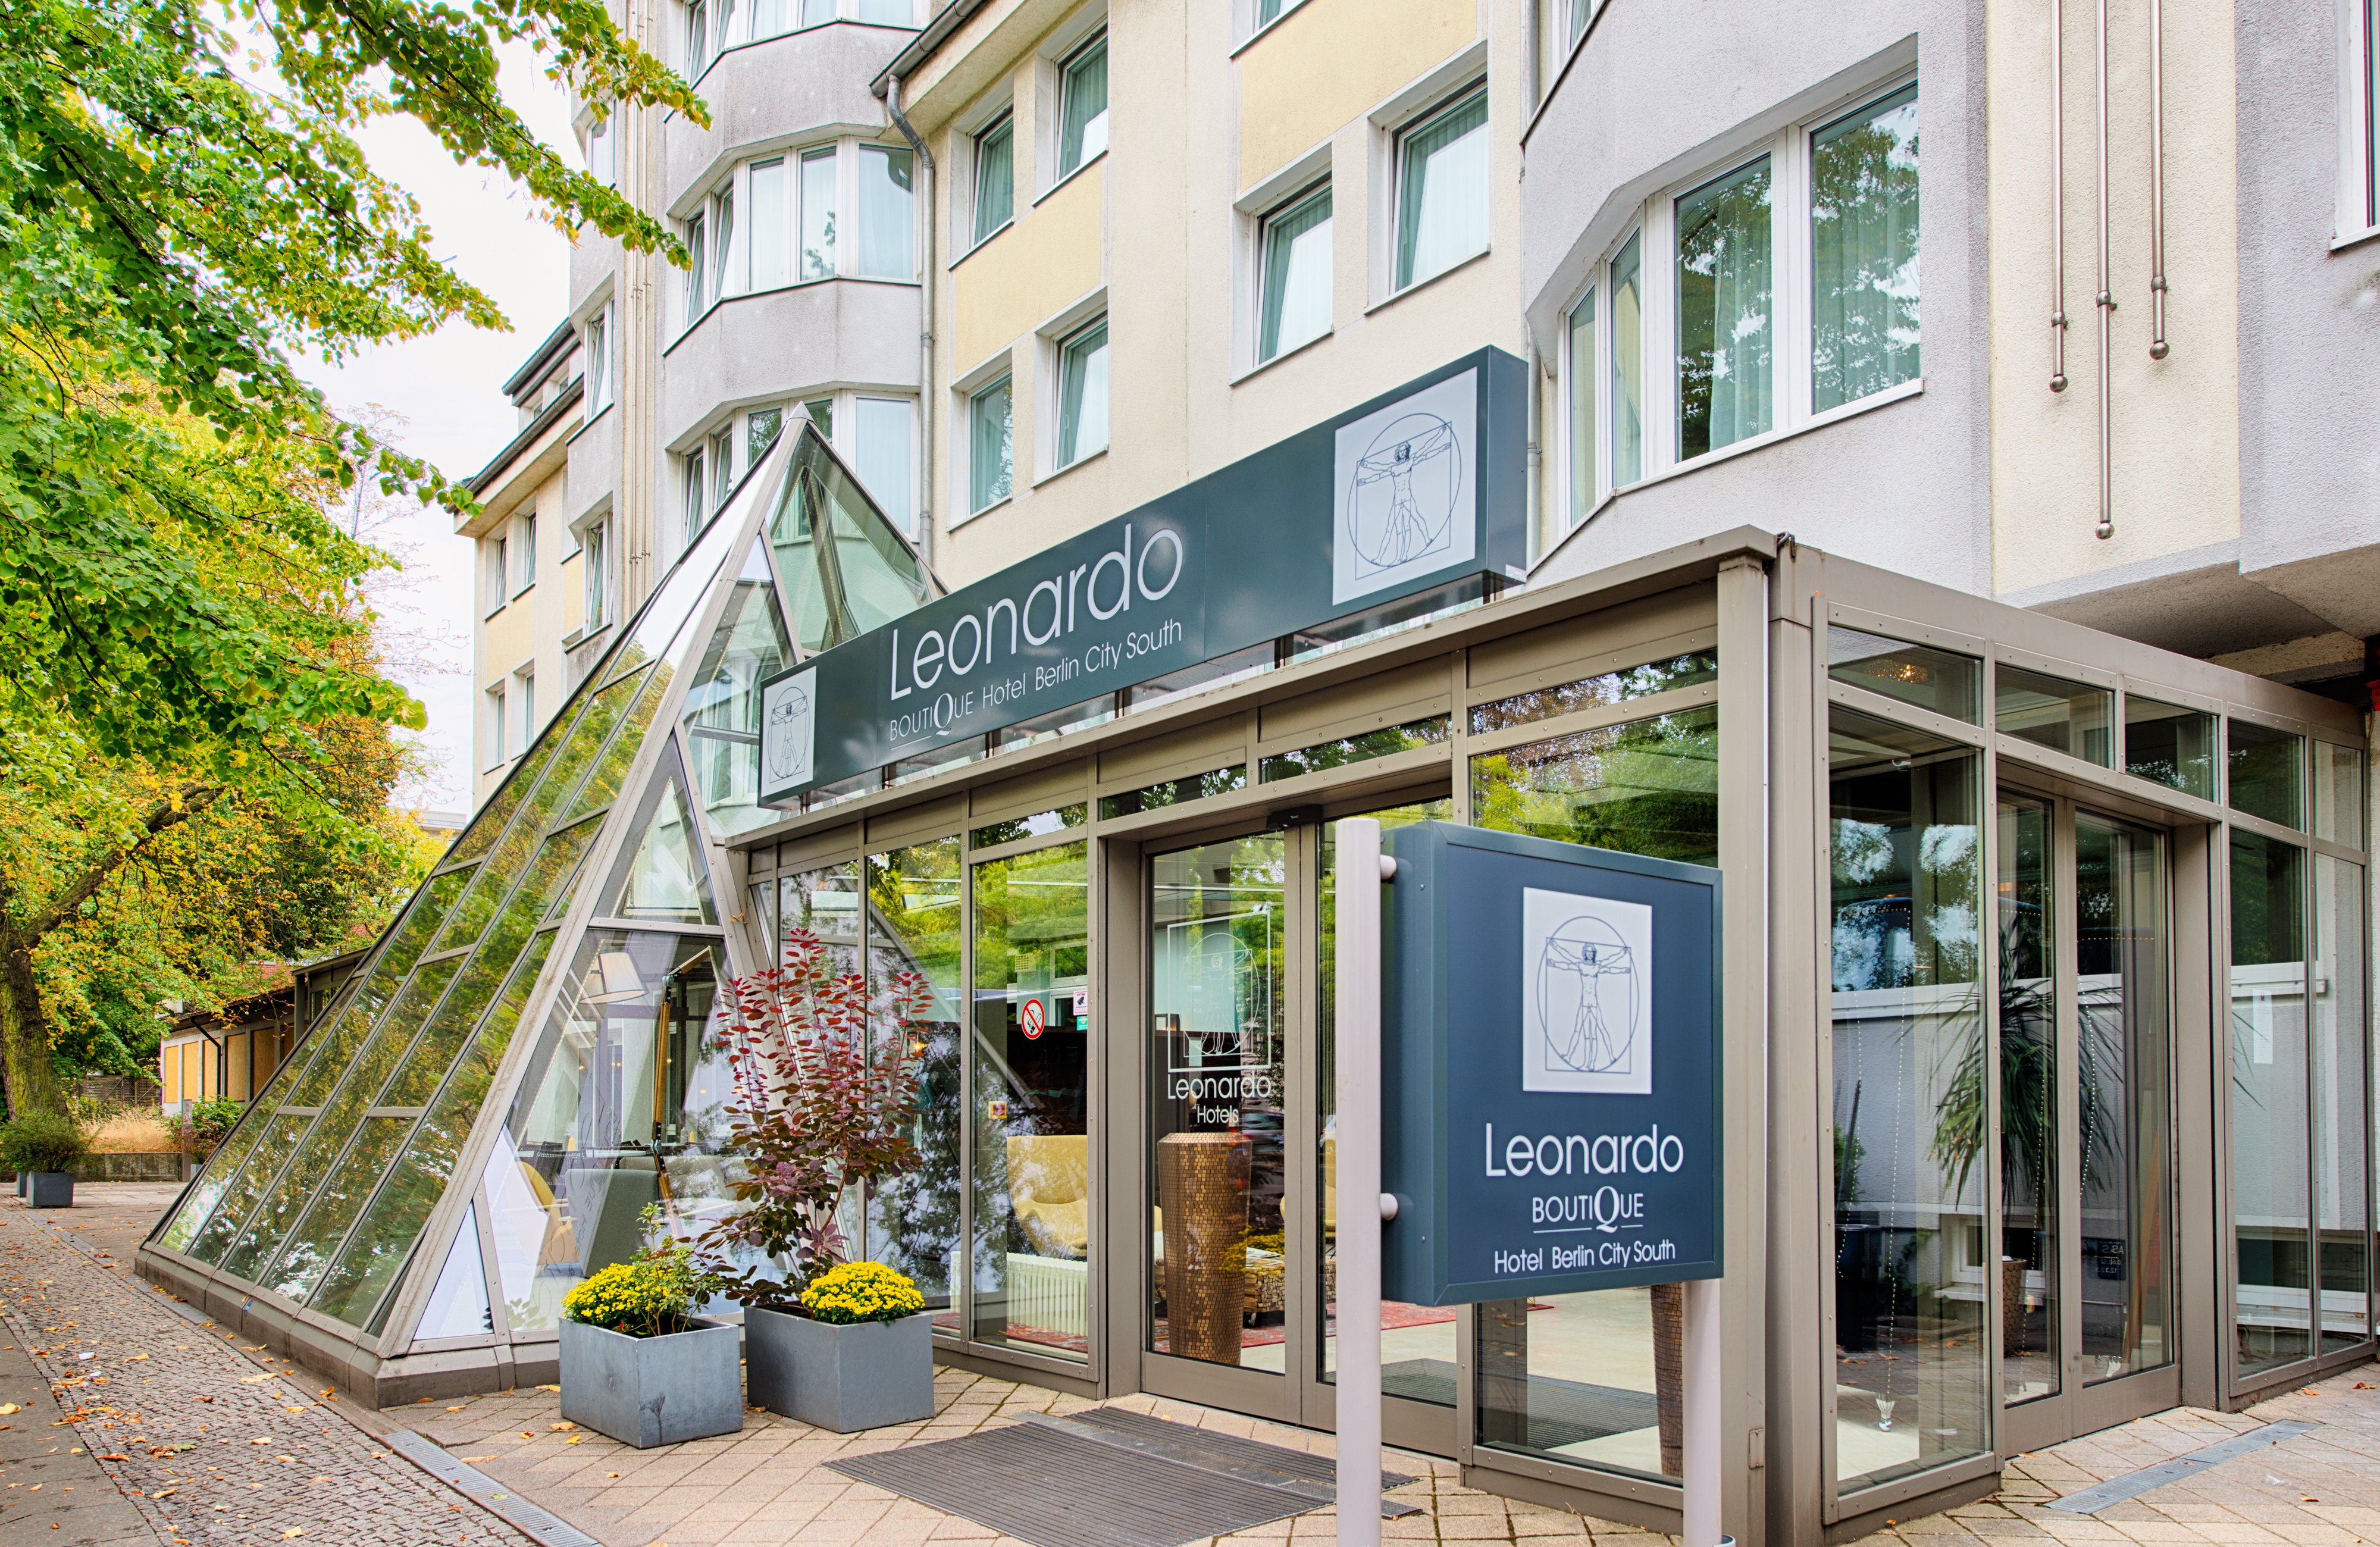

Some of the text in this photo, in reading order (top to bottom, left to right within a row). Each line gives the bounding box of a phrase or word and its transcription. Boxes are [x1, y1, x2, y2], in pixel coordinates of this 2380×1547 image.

[891, 522, 1183, 701] Leonardo
[890, 618, 1182, 737] BOUTIQUE Hotel Berlin City South
[1167, 1071, 1272, 1100] Leonardo
[1197, 1105, 1239, 1124] Hotels
[1486, 1122, 1684, 1177] Leonardo
[1532, 1185, 1644, 1233] BOUTIQUE
[1495, 1239, 1676, 1274] Hotel Berlin City South
